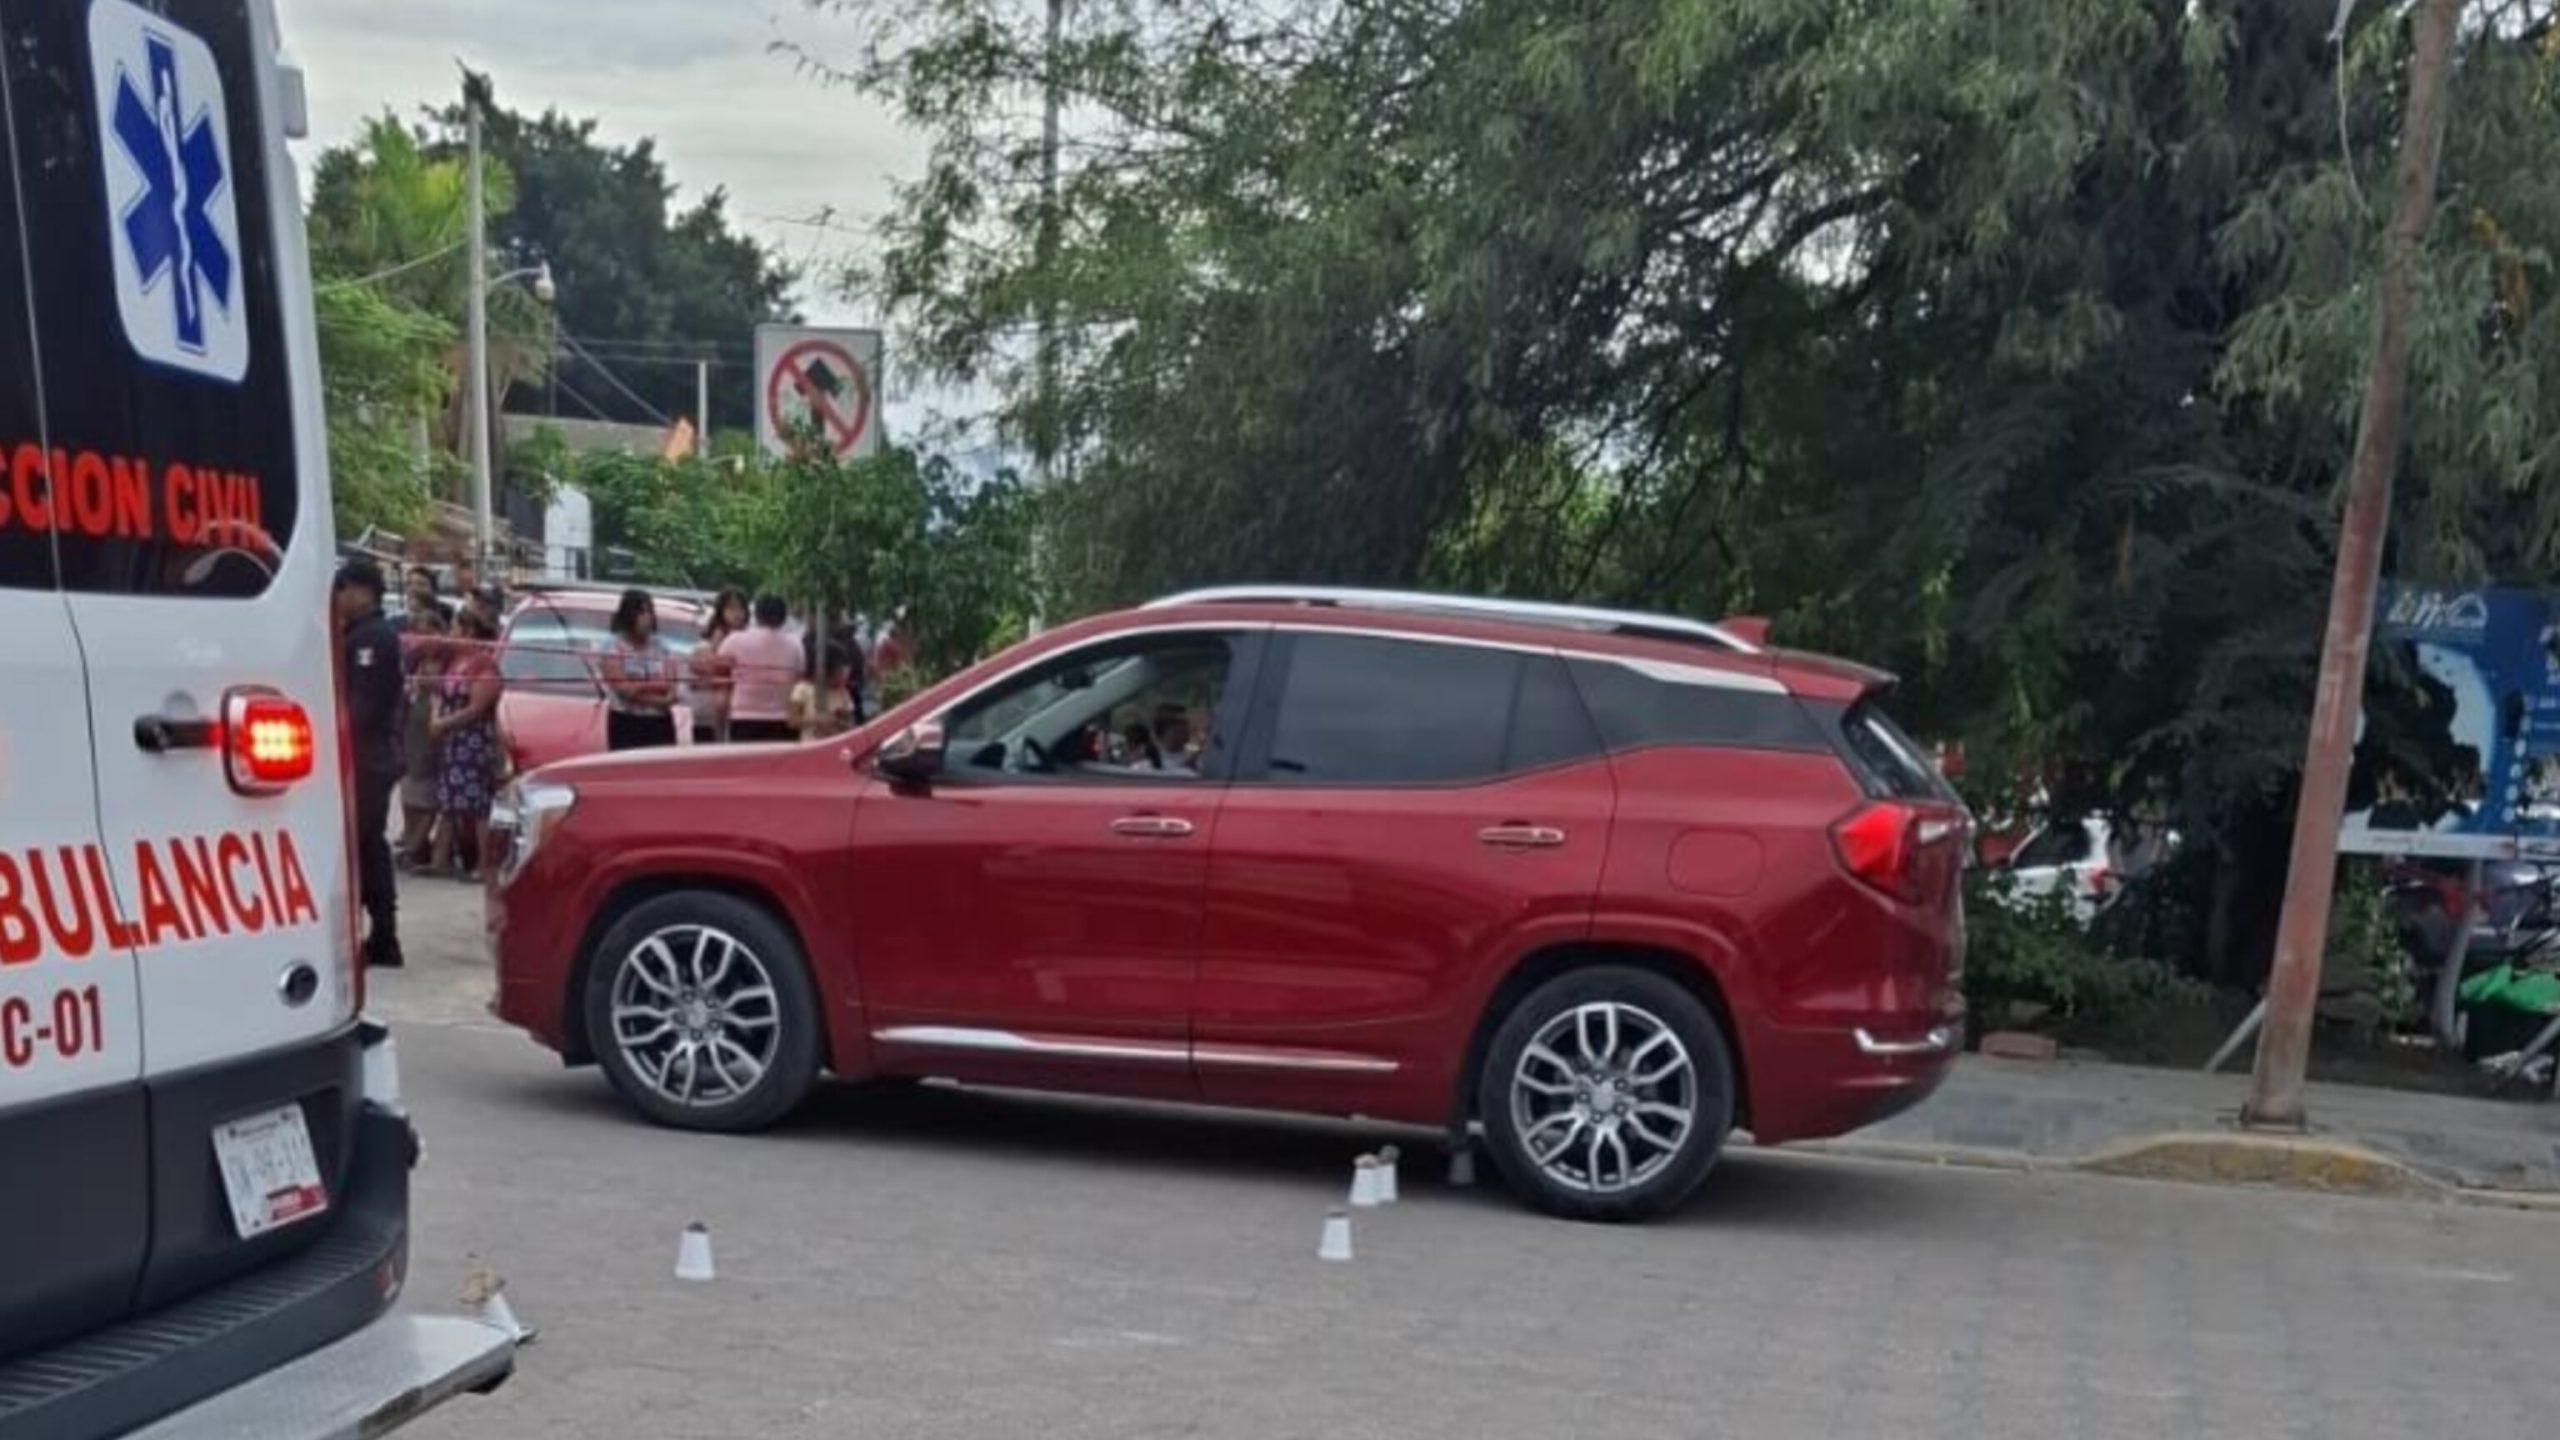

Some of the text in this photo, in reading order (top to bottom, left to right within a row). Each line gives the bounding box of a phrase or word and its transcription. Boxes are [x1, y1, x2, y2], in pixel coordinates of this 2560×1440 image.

[0, 442, 266, 547] CION CIVIL
[2, 985, 102, 1067] C-01
